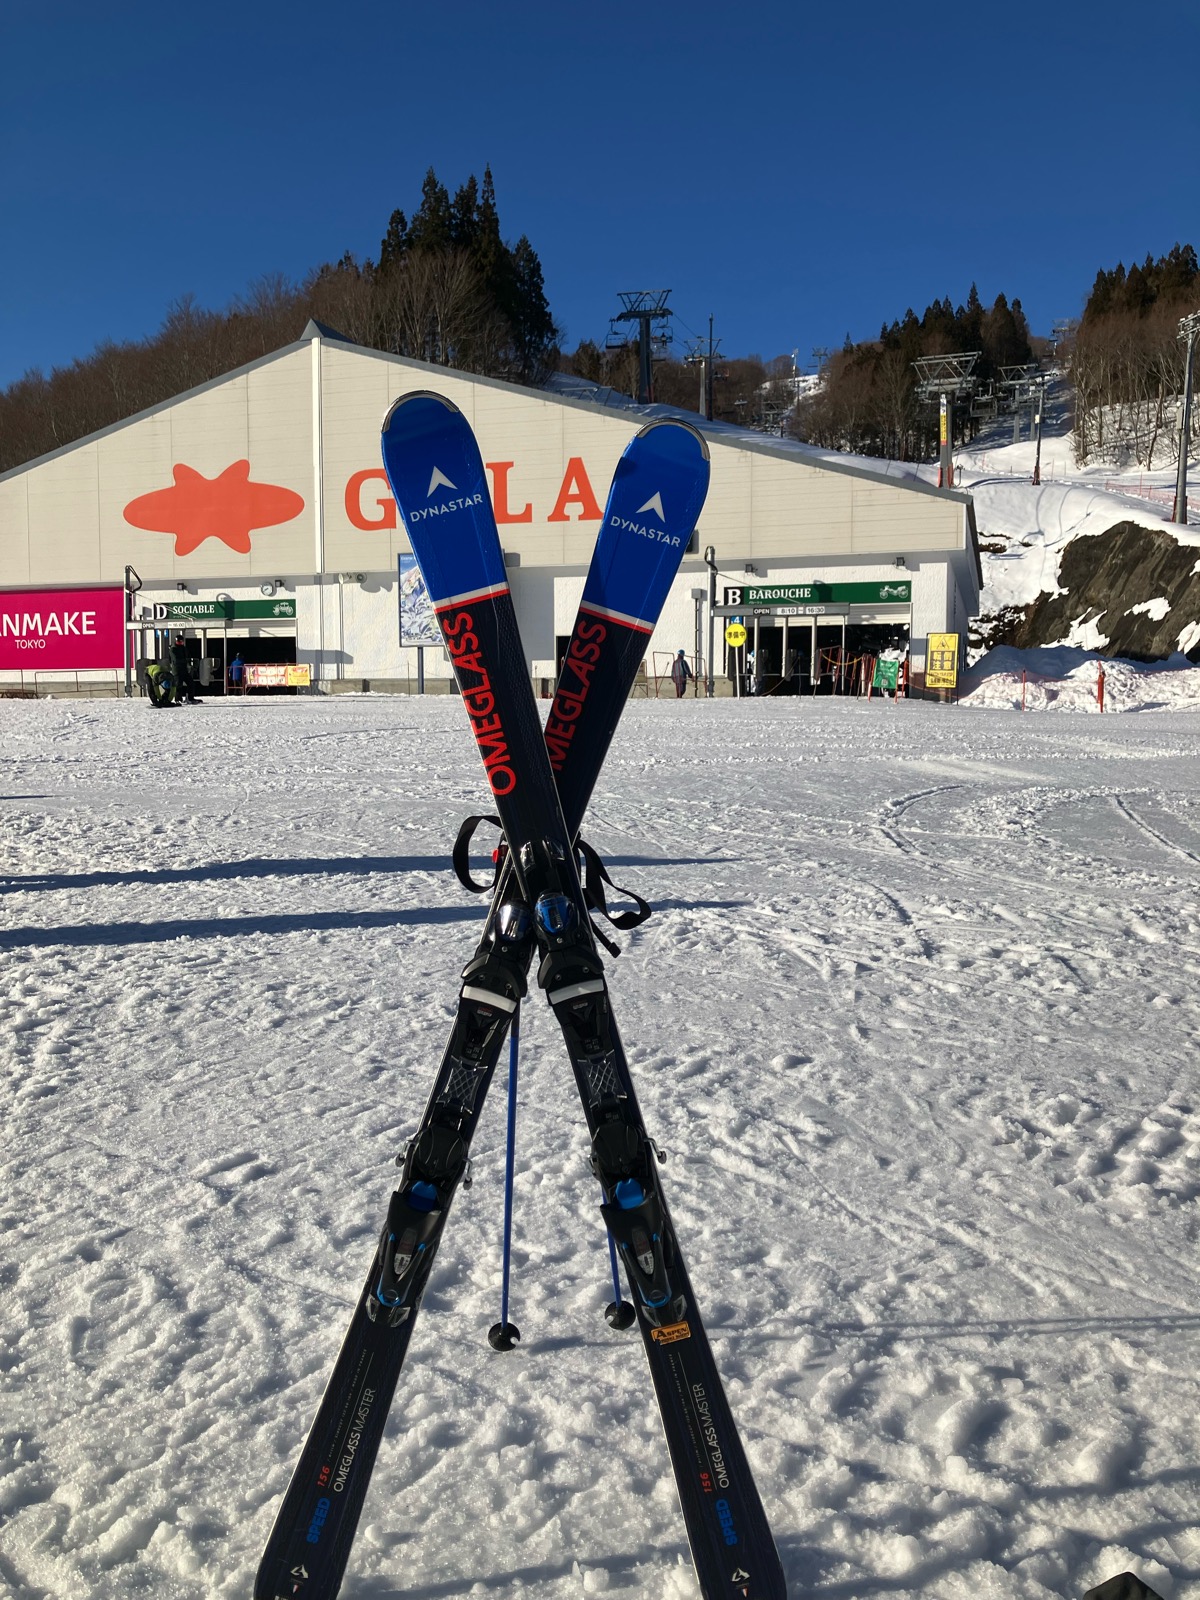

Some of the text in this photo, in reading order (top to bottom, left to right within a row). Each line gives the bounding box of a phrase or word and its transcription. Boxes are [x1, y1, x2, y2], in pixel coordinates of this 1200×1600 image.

[344, 456, 604, 531] GLA
[409, 493, 483, 522] DYNASTAR
[610, 515, 681, 549] DYNASTAR
[727, 588, 812, 605] B BAROUCHE
[0, 611, 96, 637] NMAKE
[155, 604, 215, 620] D SOCIABLE
[15, 639, 46, 649] TOKYO
[442, 612, 516, 796] OMEGLASS
[546, 620, 607, 771] MEGLASS
[317, 1465, 331, 1487] 156
[700, 1472, 712, 1493] 156
[306, 1496, 331, 1544] SPEED
[715, 1499, 738, 1546] SPEED
